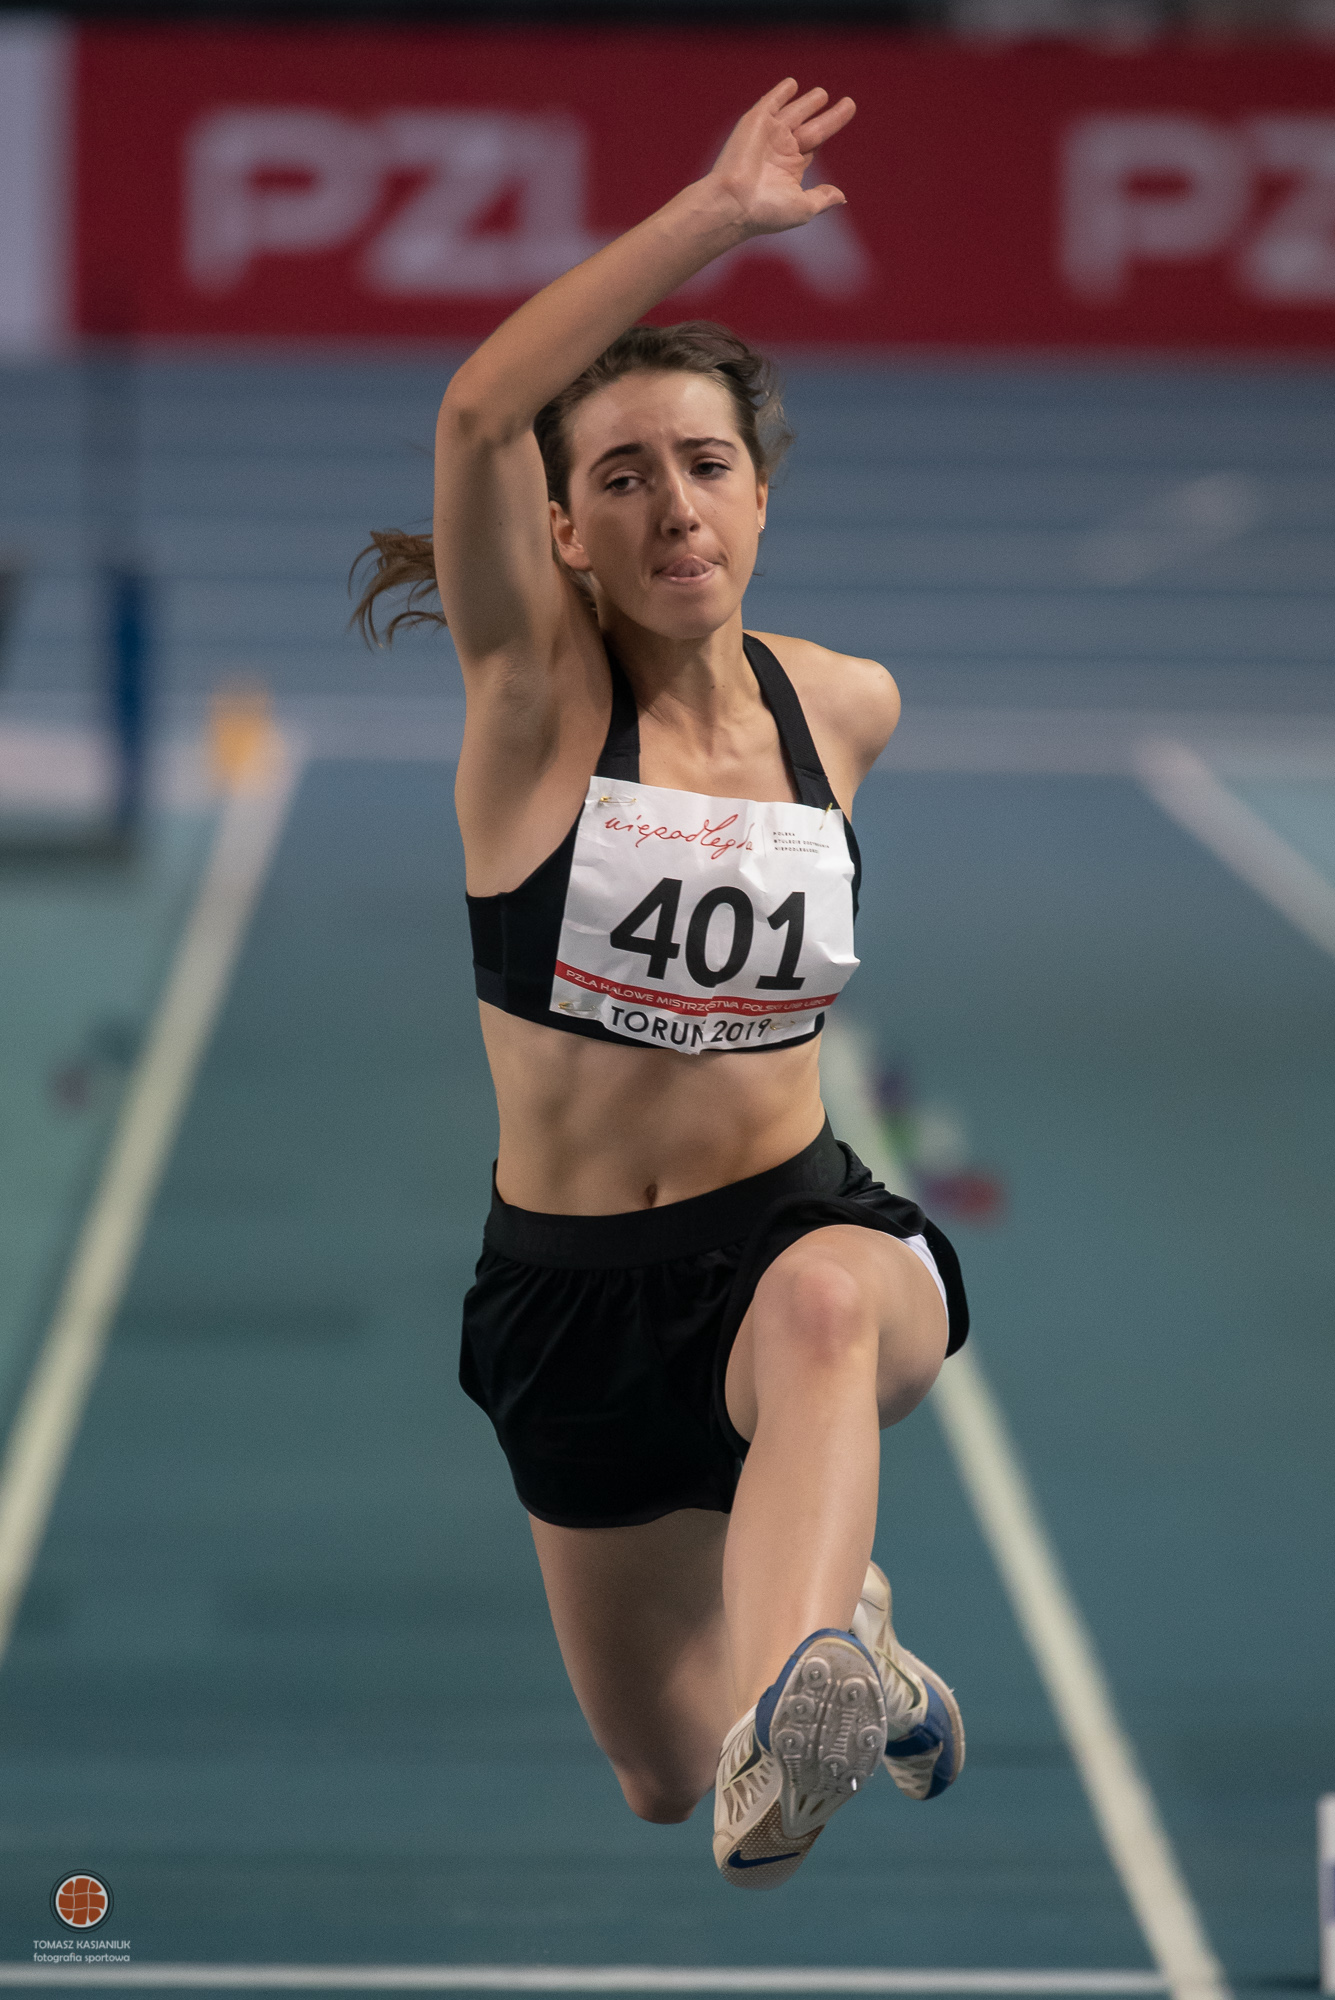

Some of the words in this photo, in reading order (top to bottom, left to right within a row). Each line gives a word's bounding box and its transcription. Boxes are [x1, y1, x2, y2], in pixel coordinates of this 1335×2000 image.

[609, 876, 806, 991] 401
[565, 968, 599, 989] PZLA
[600, 982, 655, 1003] HALOWE
[709, 1017, 773, 1043] 2019
